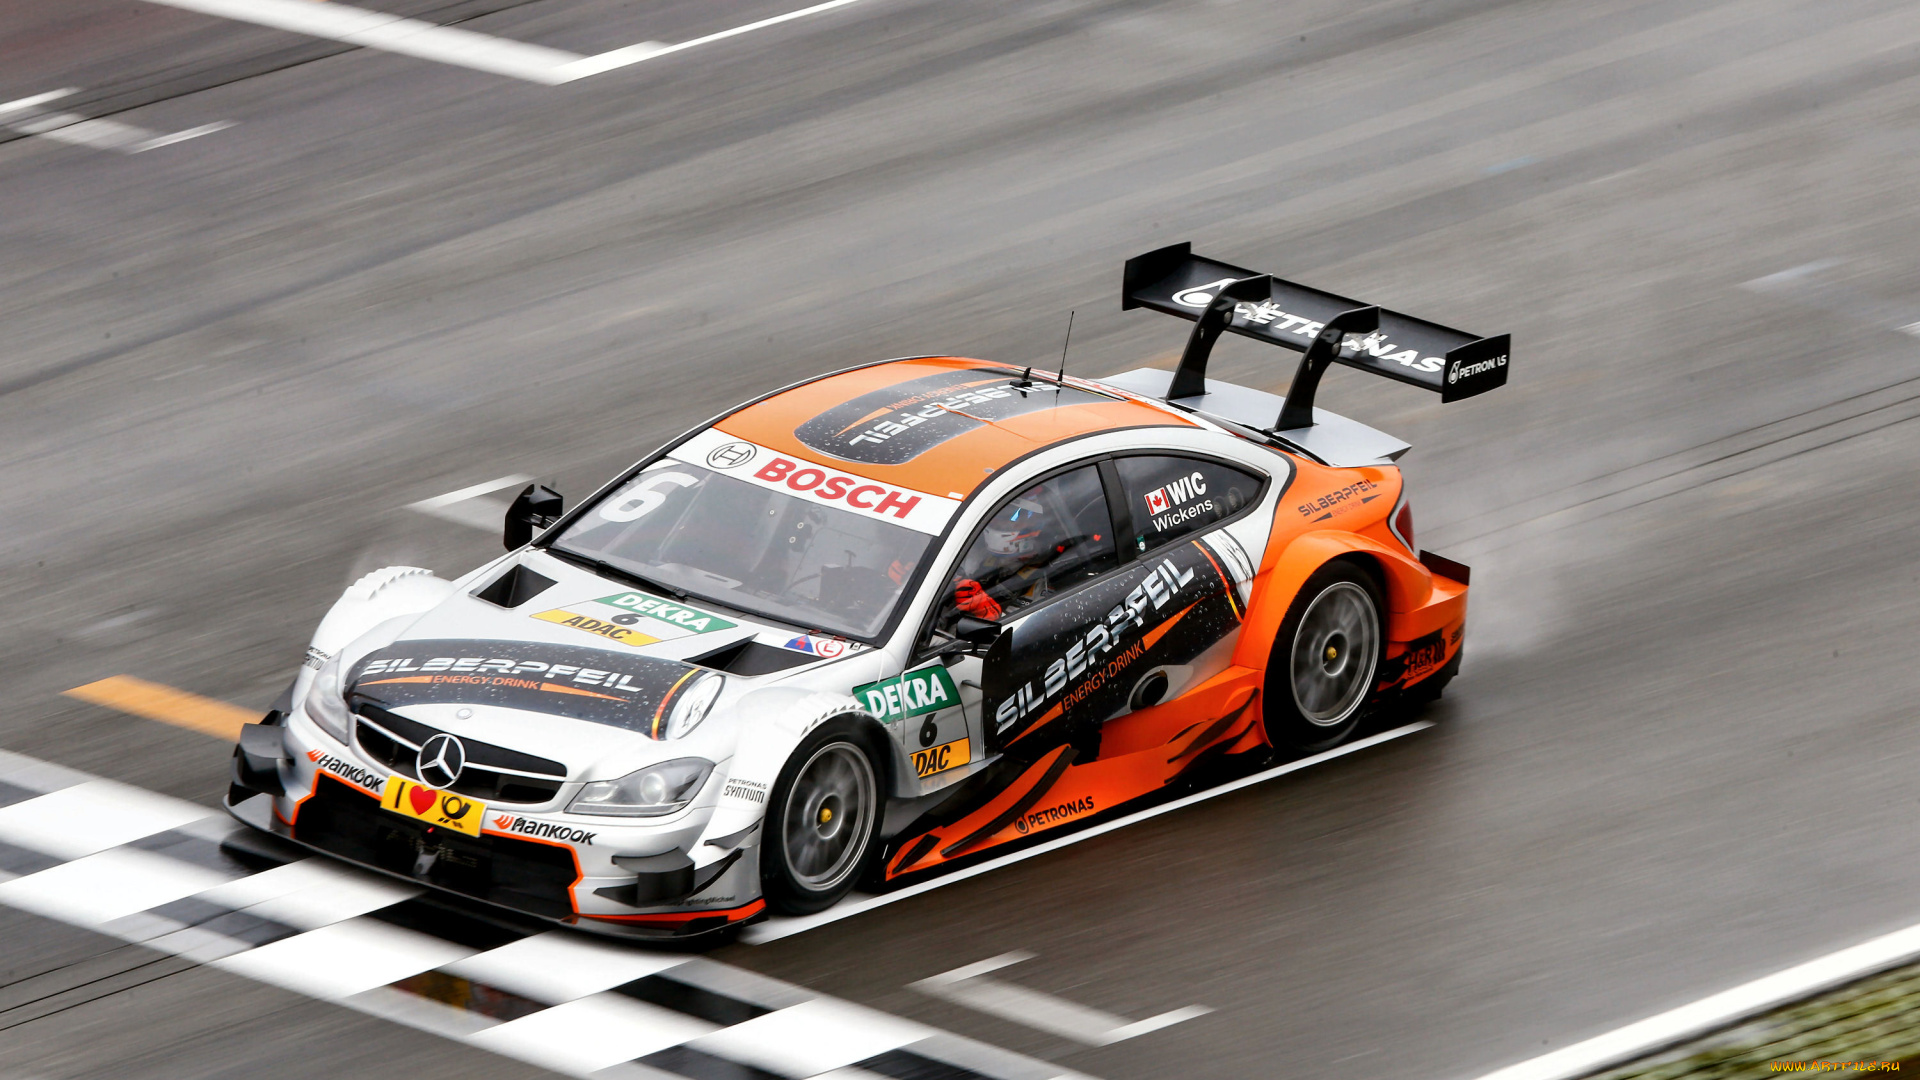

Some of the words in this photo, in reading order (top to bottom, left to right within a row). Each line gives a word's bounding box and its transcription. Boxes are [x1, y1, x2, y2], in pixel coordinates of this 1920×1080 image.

[599, 471, 700, 523] 6
[753, 457, 922, 519] BOSCH
[1166, 471, 1207, 505] WIC
[1298, 479, 1378, 517] SILBERPFEIL
[1152, 499, 1213, 532] Wickens
[562, 615, 631, 640] ADAC
[611, 613, 640, 626] 6
[612, 593, 713, 632] DEKRA
[995, 558, 1195, 736] SILBERPFEIL
[361, 657, 645, 693] SILBERPFEIL
[433, 674, 488, 686] ENERGY
[492, 677, 540, 691] DRINK
[1063, 669, 1107, 711] ENERGY
[1108, 640, 1144, 677] DRINK
[866, 673, 948, 719] DEKRA
[919, 712, 938, 748] 6
[911, 745, 951, 777] DAC
[394, 781, 406, 809] I
[723, 784, 765, 804] SYNTIUM
[728, 778, 767, 790] PETRONAS
[1028, 796, 1095, 829] PETRONAS
